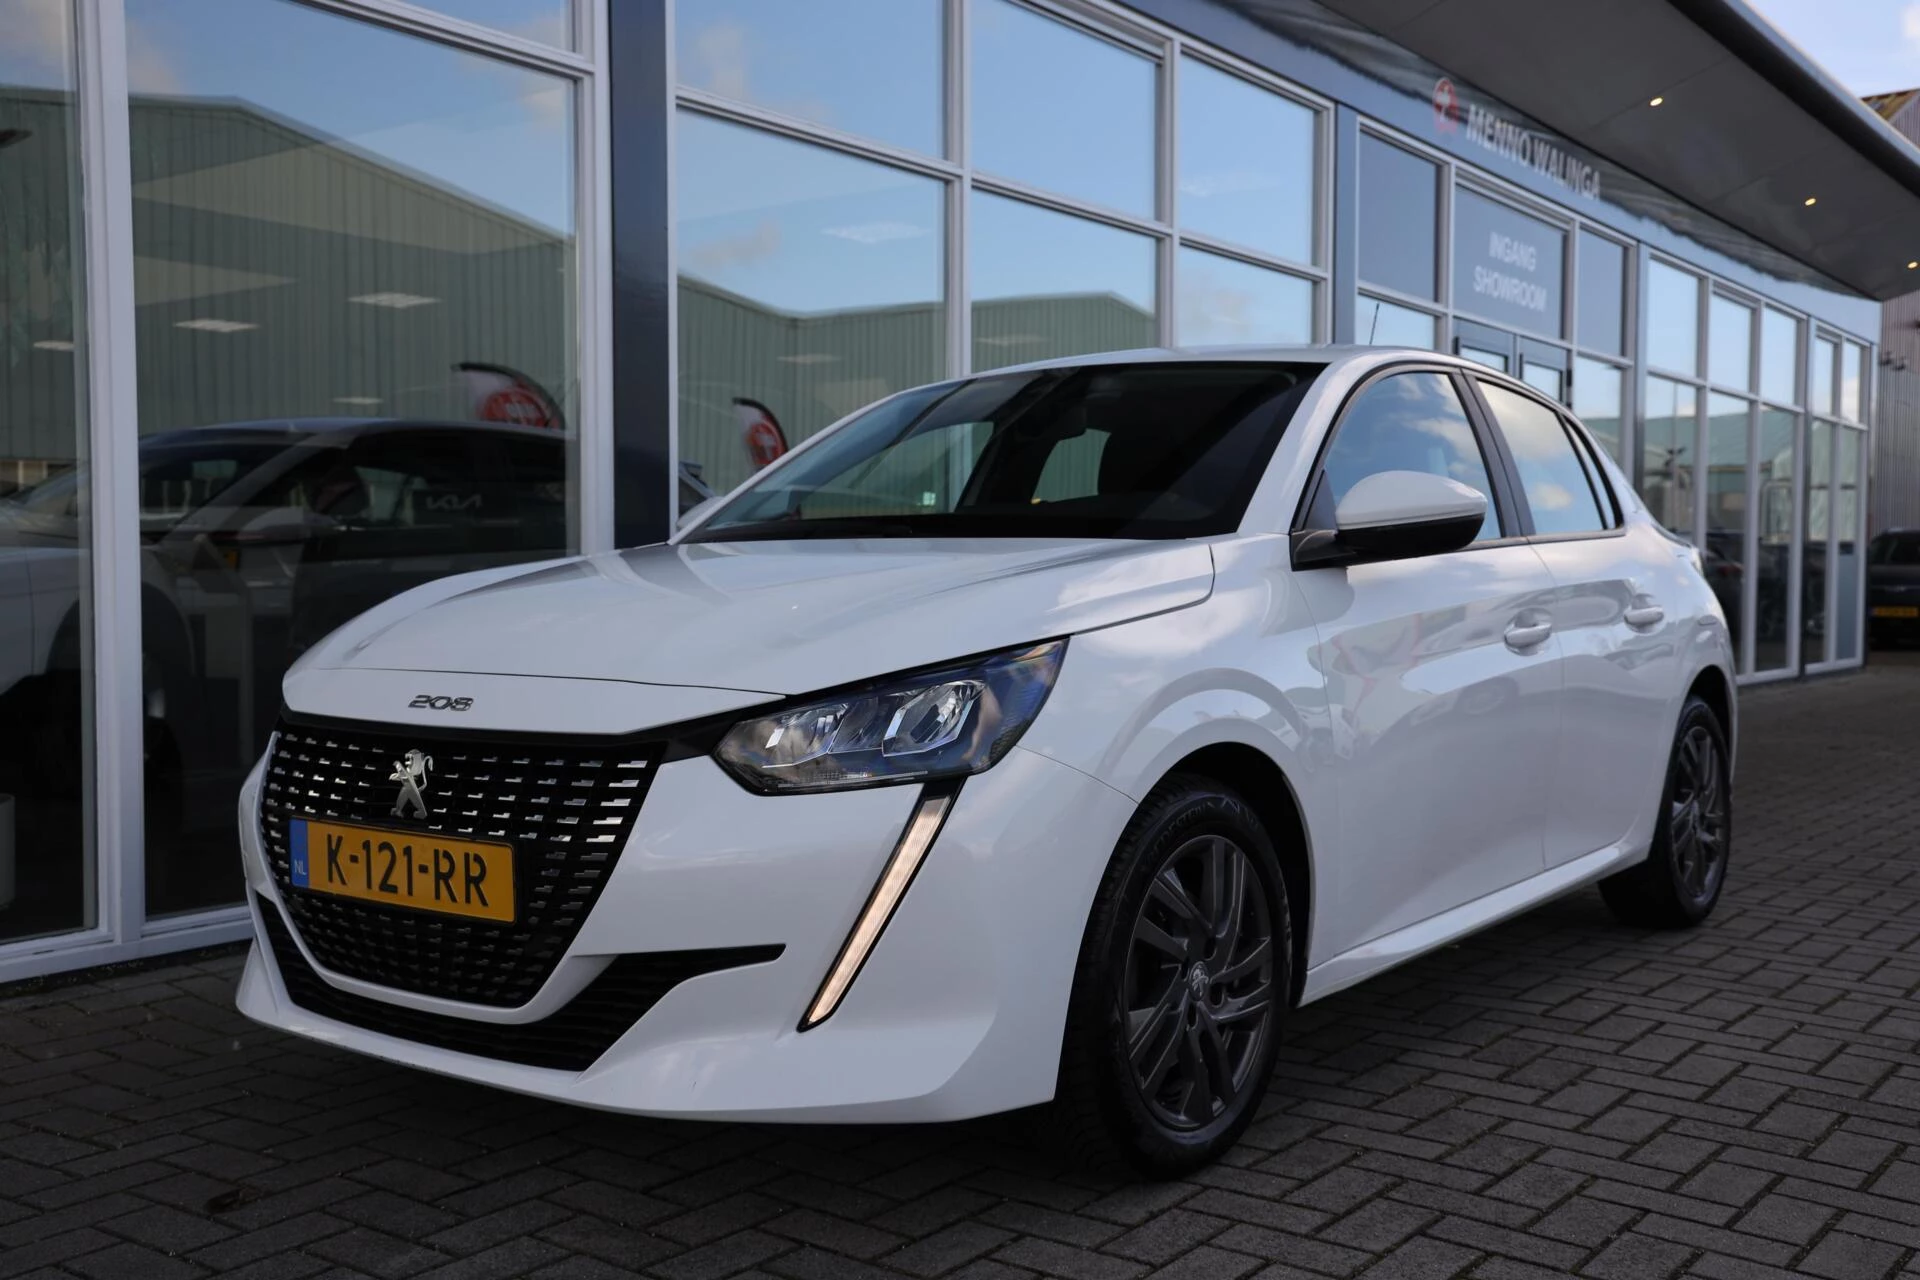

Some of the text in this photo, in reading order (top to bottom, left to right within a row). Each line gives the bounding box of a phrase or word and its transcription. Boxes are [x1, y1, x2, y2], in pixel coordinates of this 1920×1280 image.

[1466, 103, 1600, 200] MENNO WALINGA
[1489, 231, 1537, 272] INGANG
[1473, 265, 1548, 312] SHOWROOM
[408, 694, 474, 711] 208
[293, 858, 308, 876] NL
[326, 833, 489, 908] K-121-RR
